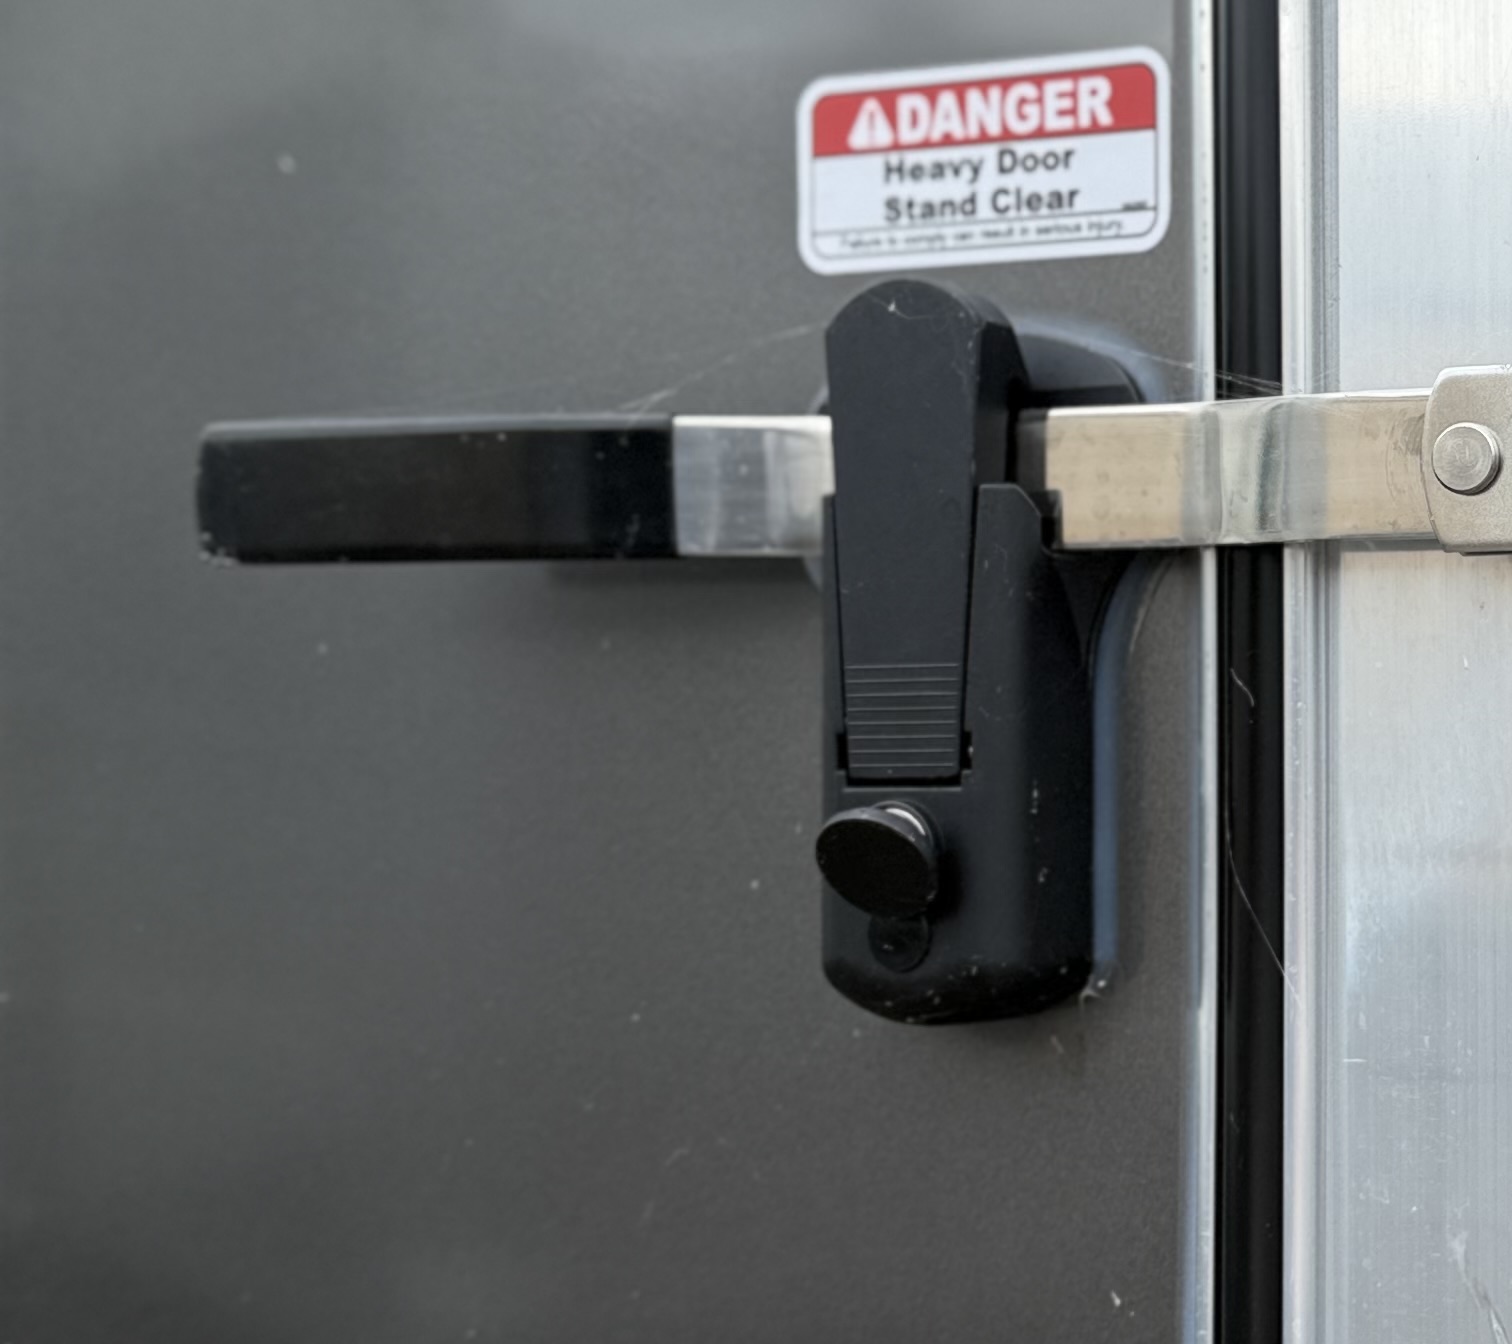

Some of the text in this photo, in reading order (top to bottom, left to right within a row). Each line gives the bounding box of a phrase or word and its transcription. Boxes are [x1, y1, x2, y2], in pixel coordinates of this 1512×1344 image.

[896, 76, 1114, 146] DANGER
[883, 148, 1076, 186] Heavy Door
[884, 188, 1080, 225] Stand Clear
